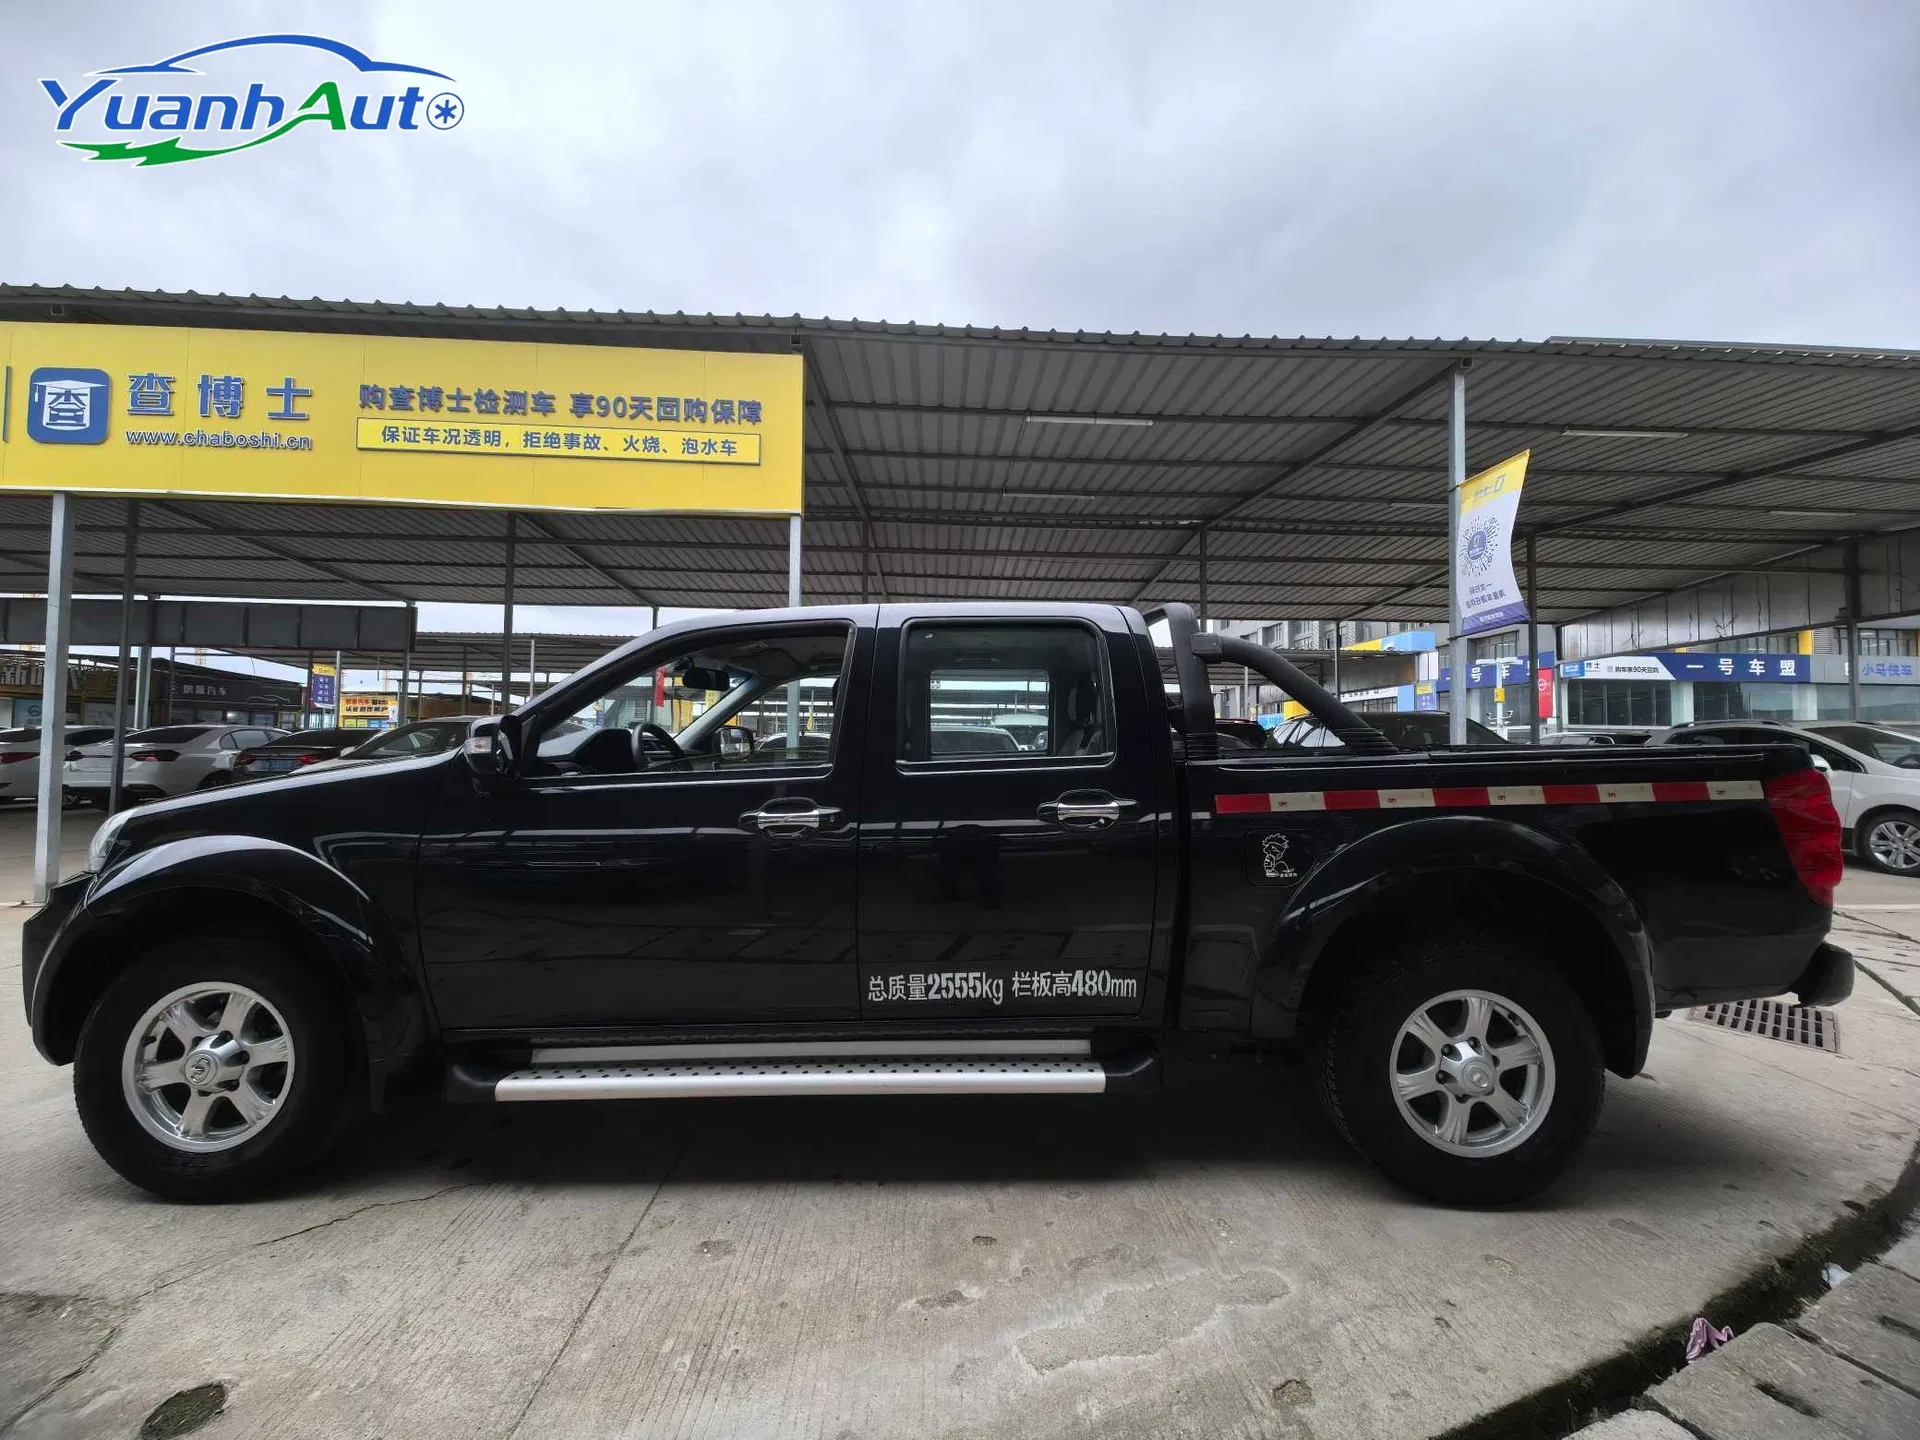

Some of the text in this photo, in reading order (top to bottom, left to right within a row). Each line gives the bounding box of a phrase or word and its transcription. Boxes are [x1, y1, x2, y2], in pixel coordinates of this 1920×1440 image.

[126, 372, 311, 420] 查博士
[358, 383, 763, 426] 购查博士检测车 享90天回购保障
[125, 429, 312, 450] www.chaboshi.cn
[1685, 658, 1797, 677] 一号车盟
[867, 969, 1137, 1005] 总质量2555kg 栏板高480mm
